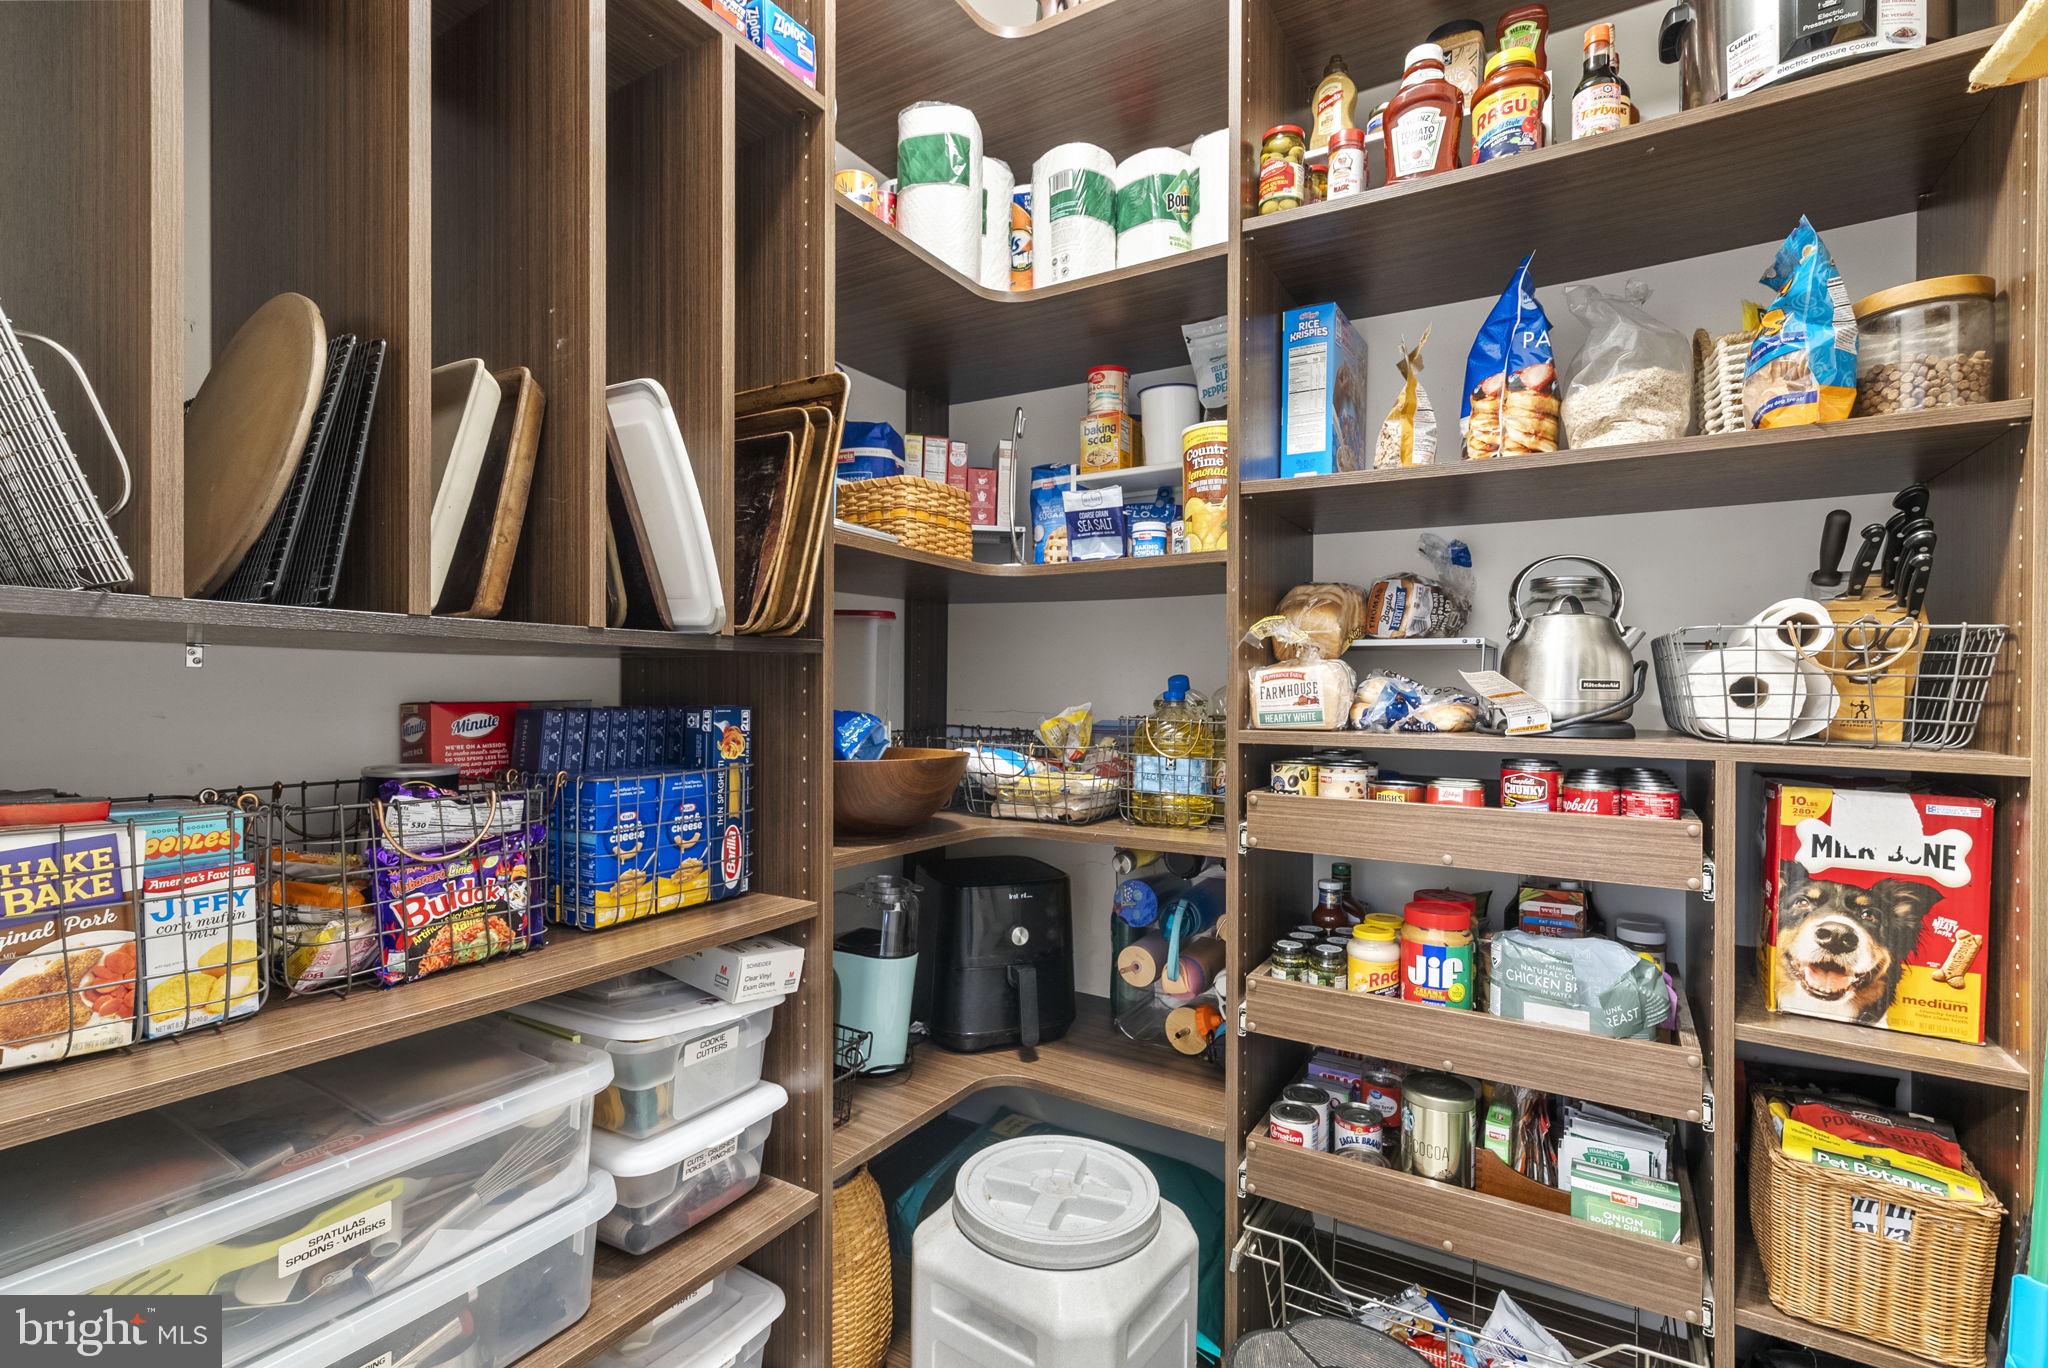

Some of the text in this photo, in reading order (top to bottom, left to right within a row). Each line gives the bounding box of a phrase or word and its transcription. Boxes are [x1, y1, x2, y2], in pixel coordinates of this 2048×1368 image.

[1802, 10, 1859, 31] Pressure Cooker
[1817, 8, 1844, 20] Electric
[746, 6, 760, 43] Ziploc
[773, 12, 807, 43] Ziploc
[1509, 24, 1531, 35] HEINZ
[1776, 40, 1879, 75] electric pressure cooker
[1505, 118, 1522, 130] Style
[1401, 125, 1435, 140] TOMATO
[1298, 319, 1320, 331] RICE
[1289, 326, 1328, 342] KRISPIES
[1096, 383, 1116, 391] Creamy
[1084, 423, 1117, 436] baking
[1087, 434, 1112, 446] soda
[1192, 456, 1224, 470] Time
[1187, 467, 1228, 483] Lemonad
[1039, 512, 1064, 520] SUGAR
[1079, 510, 1109, 519] COARSE GRAIN
[1077, 518, 1113, 533] SEA SALT
[1380, 592, 1394, 625] Bagels
[1391, 591, 1406, 628] EVERYTHING
[1290, 671, 1303, 679] FARM
[1260, 682, 1319, 700] FARMHOUSE
[1583, 681, 1620, 689] KitchenAid
[1264, 712, 1317, 723] HEARTY WHITE
[452, 715, 500, 735] Minute
[717, 760, 725, 804] SPAGHETI
[1510, 777, 1535, 785] Campbell's
[1504, 783, 1544, 795] CHUNKY
[1790, 796, 1806, 806] 10
[1792, 807, 1816, 815] 280+
[411, 821, 427, 829] 530
[726, 830, 737, 874] Barilla
[0, 847, 115, 889] HAKE
[447, 862, 474, 878] Lime
[1, 872, 115, 918] BAKE
[150, 889, 250, 923] JIFFY
[462, 906, 483, 916] Chicken
[1540, 906, 1562, 915] weis
[63, 908, 118, 933] Pork
[1932, 919, 1959, 932] MEATY
[188, 926, 219, 940] mix
[3, 951, 17, 960] MIX
[744, 972, 772, 983] Clear Vinyl
[1407, 955, 1464, 989] Jif
[758, 981, 776, 989] Gloves
[1505, 969, 1560, 991] CHICKEN
[1414, 987, 1443, 996] CREAMY
[1550, 991, 1572, 999] WATER
[1902, 996, 1968, 1013] medium
[155, 1022, 175, 1033] NET WT
[699, 1033, 726, 1049] COOKIE
[696, 1041, 728, 1059] CUTTERS
[1339, 1136, 1359, 1146] EAGLE
[686, 1136, 736, 1167] CUTS CRUSHES
[1412, 1138, 1450, 1162] COCOA
[1589, 1147, 1625, 1160] Hidden Valley
[685, 1144, 736, 1175] POKES PINCHES
[1590, 1156, 1624, 1170] Ranch
[1817, 1151, 1850, 1171] Pet
[1853, 1160, 1945, 1197] Botanics
[1612, 1193, 1638, 1204] weis
[1603, 1211, 1644, 1227] ONION
[307, 1216, 366, 1248] SPATULAS
[1590, 1215, 1614, 1226] SOUP
[1624, 1224, 1639, 1232] DIP
[1640, 1228, 1658, 1238] MIX
[285, 1217, 386, 1269] SPOONS WHISKS
